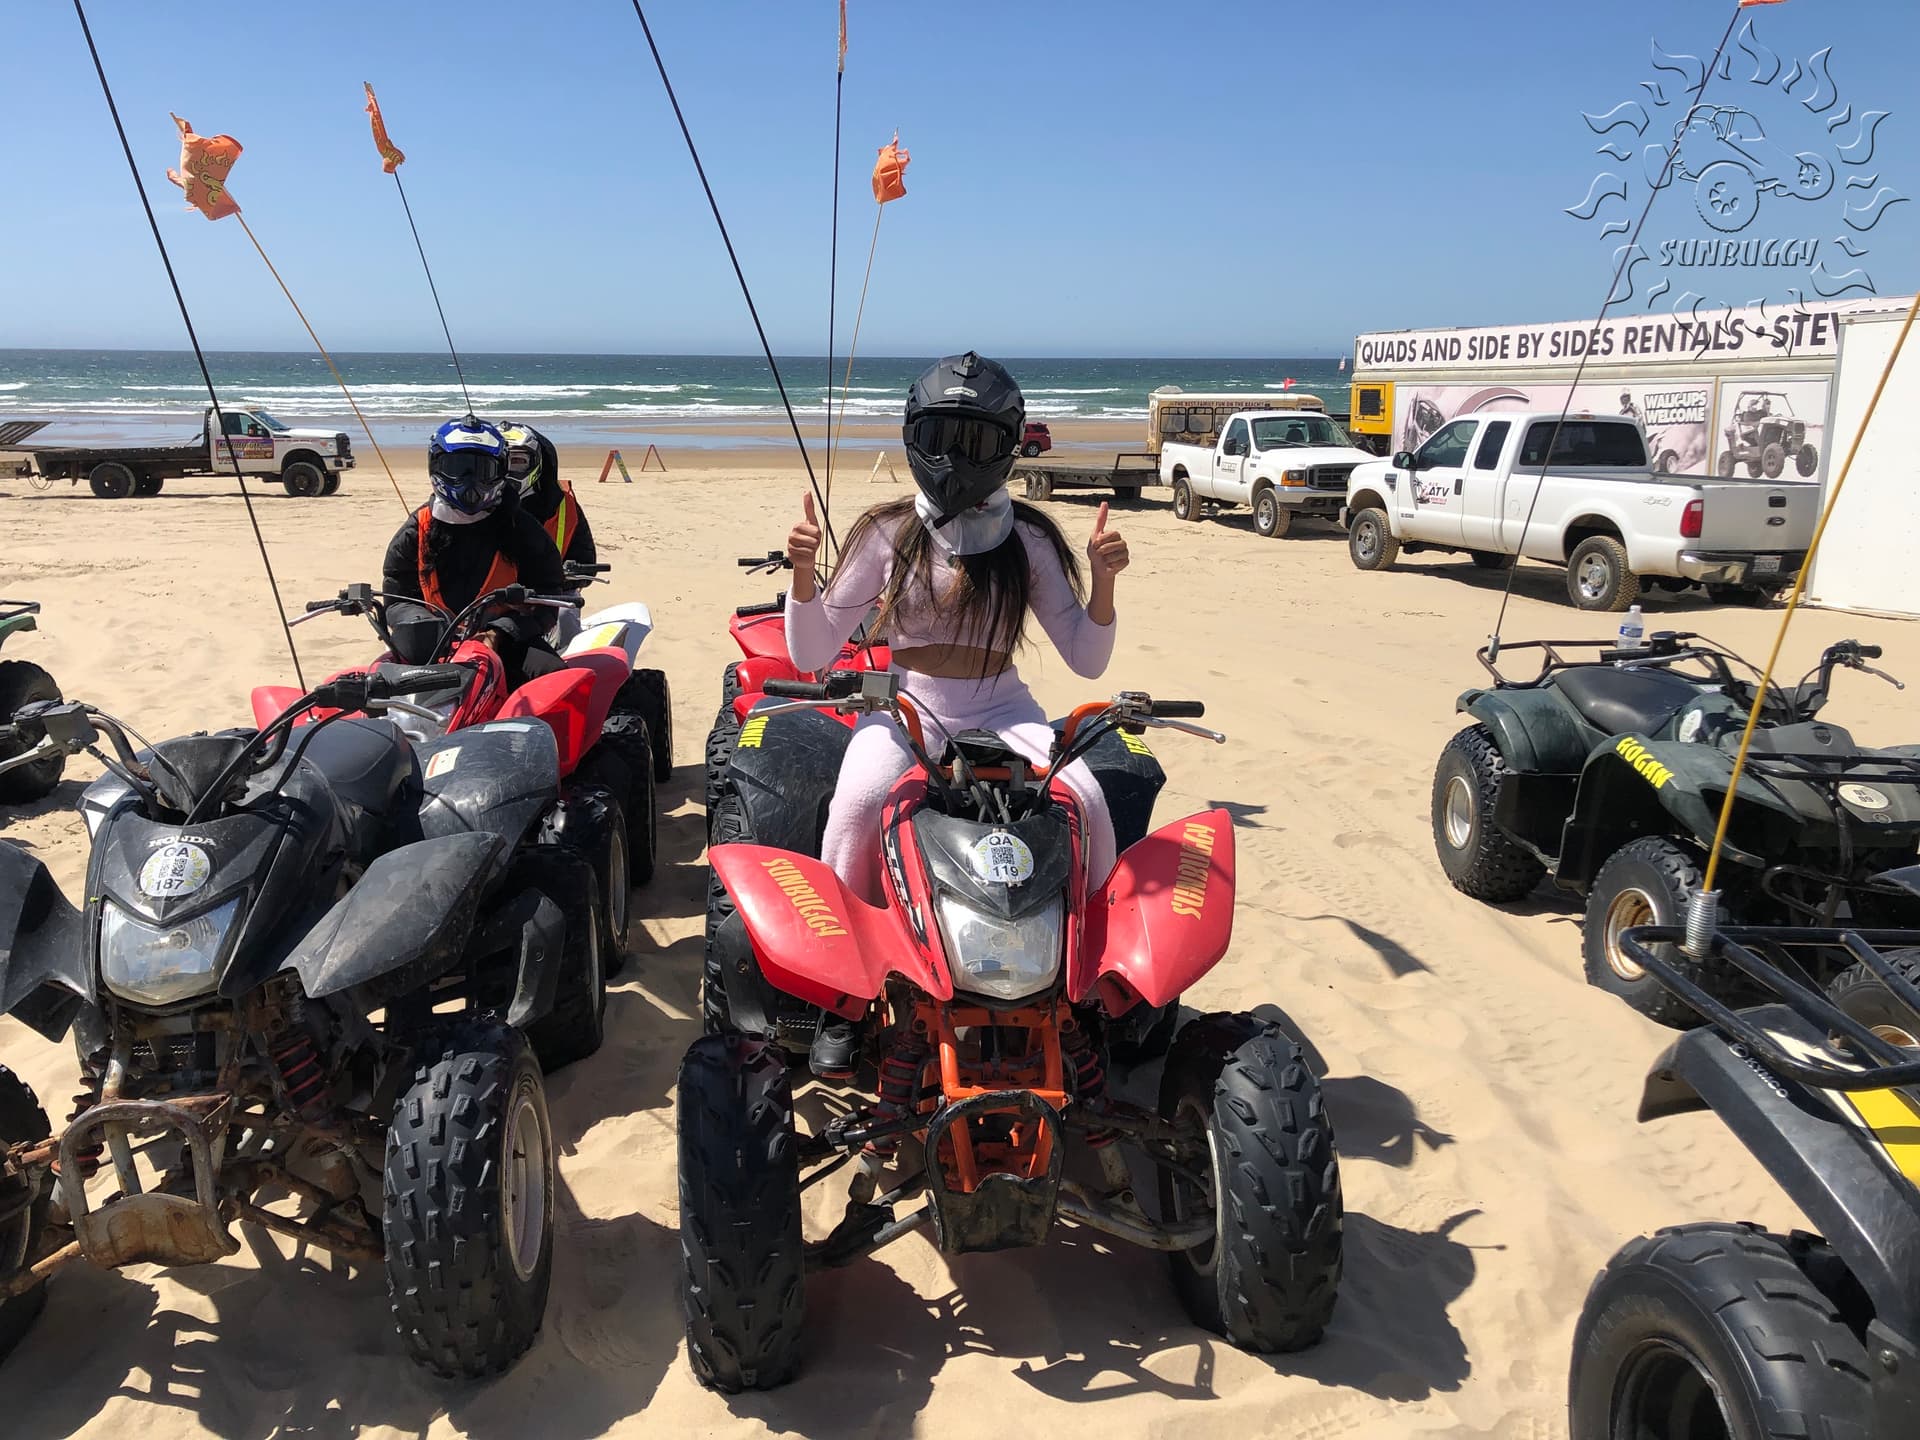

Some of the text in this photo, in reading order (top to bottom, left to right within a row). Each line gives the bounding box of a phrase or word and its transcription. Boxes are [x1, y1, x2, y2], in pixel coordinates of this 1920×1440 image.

[1361, 339, 1417, 365] QUADS
[1421, 337, 1462, 362] AND
[1467, 334, 1510, 360] SIDE
[1517, 332, 1545, 358] BY
[1549, 326, 1615, 358] SIDES
[1623, 317, 1746, 354] RENTALS
[1645, 407, 1705, 425] WELCOME
[1429, 486, 1450, 497] ATV
[1616, 737, 1675, 789] HOGAN
[148, 834, 217, 848] HONDA
[989, 835, 1013, 846] QA
[992, 865, 1019, 877] 119
[1170, 822, 1216, 920] SUNBUGGY
[156, 878, 185, 891] 187
[760, 858, 848, 937] SUNBUGGY
[1744, 1058, 1788, 1098] KYMCO
